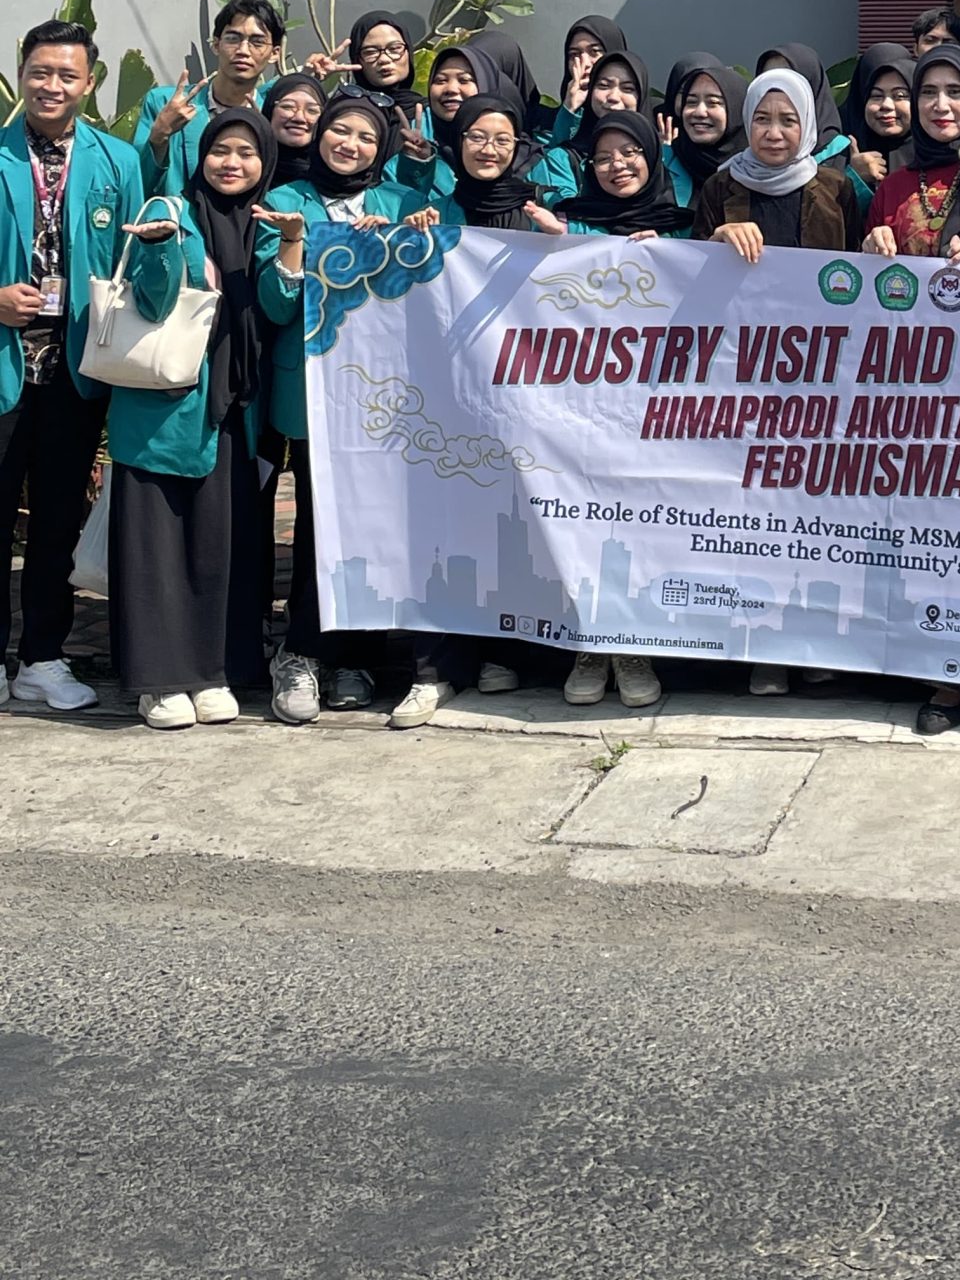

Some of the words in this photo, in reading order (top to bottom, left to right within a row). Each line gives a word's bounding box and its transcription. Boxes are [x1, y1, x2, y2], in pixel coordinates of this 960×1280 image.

[491, 325, 726, 386] INDUSTRY
[735, 325, 850, 384] VISIT
[855, 326, 957, 385] AND
[639, 395, 840, 441] HIMAPRODI
[529, 496, 581, 520] “The
[585, 502, 634, 523] Role
[638, 504, 663, 524] of
[666, 506, 761, 531] Students
[766, 511, 788, 534] in
[791, 516, 905, 548] Advancing
[690, 533, 782, 558] Enhance
[786, 539, 822, 562] the
[693, 595, 717, 606] 23rd
[718, 595, 739, 609] July
[740, 600, 765, 608] 2024
[694, 583, 740, 597] Tuesday,
[946, 609, 960, 620] De
[567, 629, 724, 651] himaprodiakuntansiunisma
